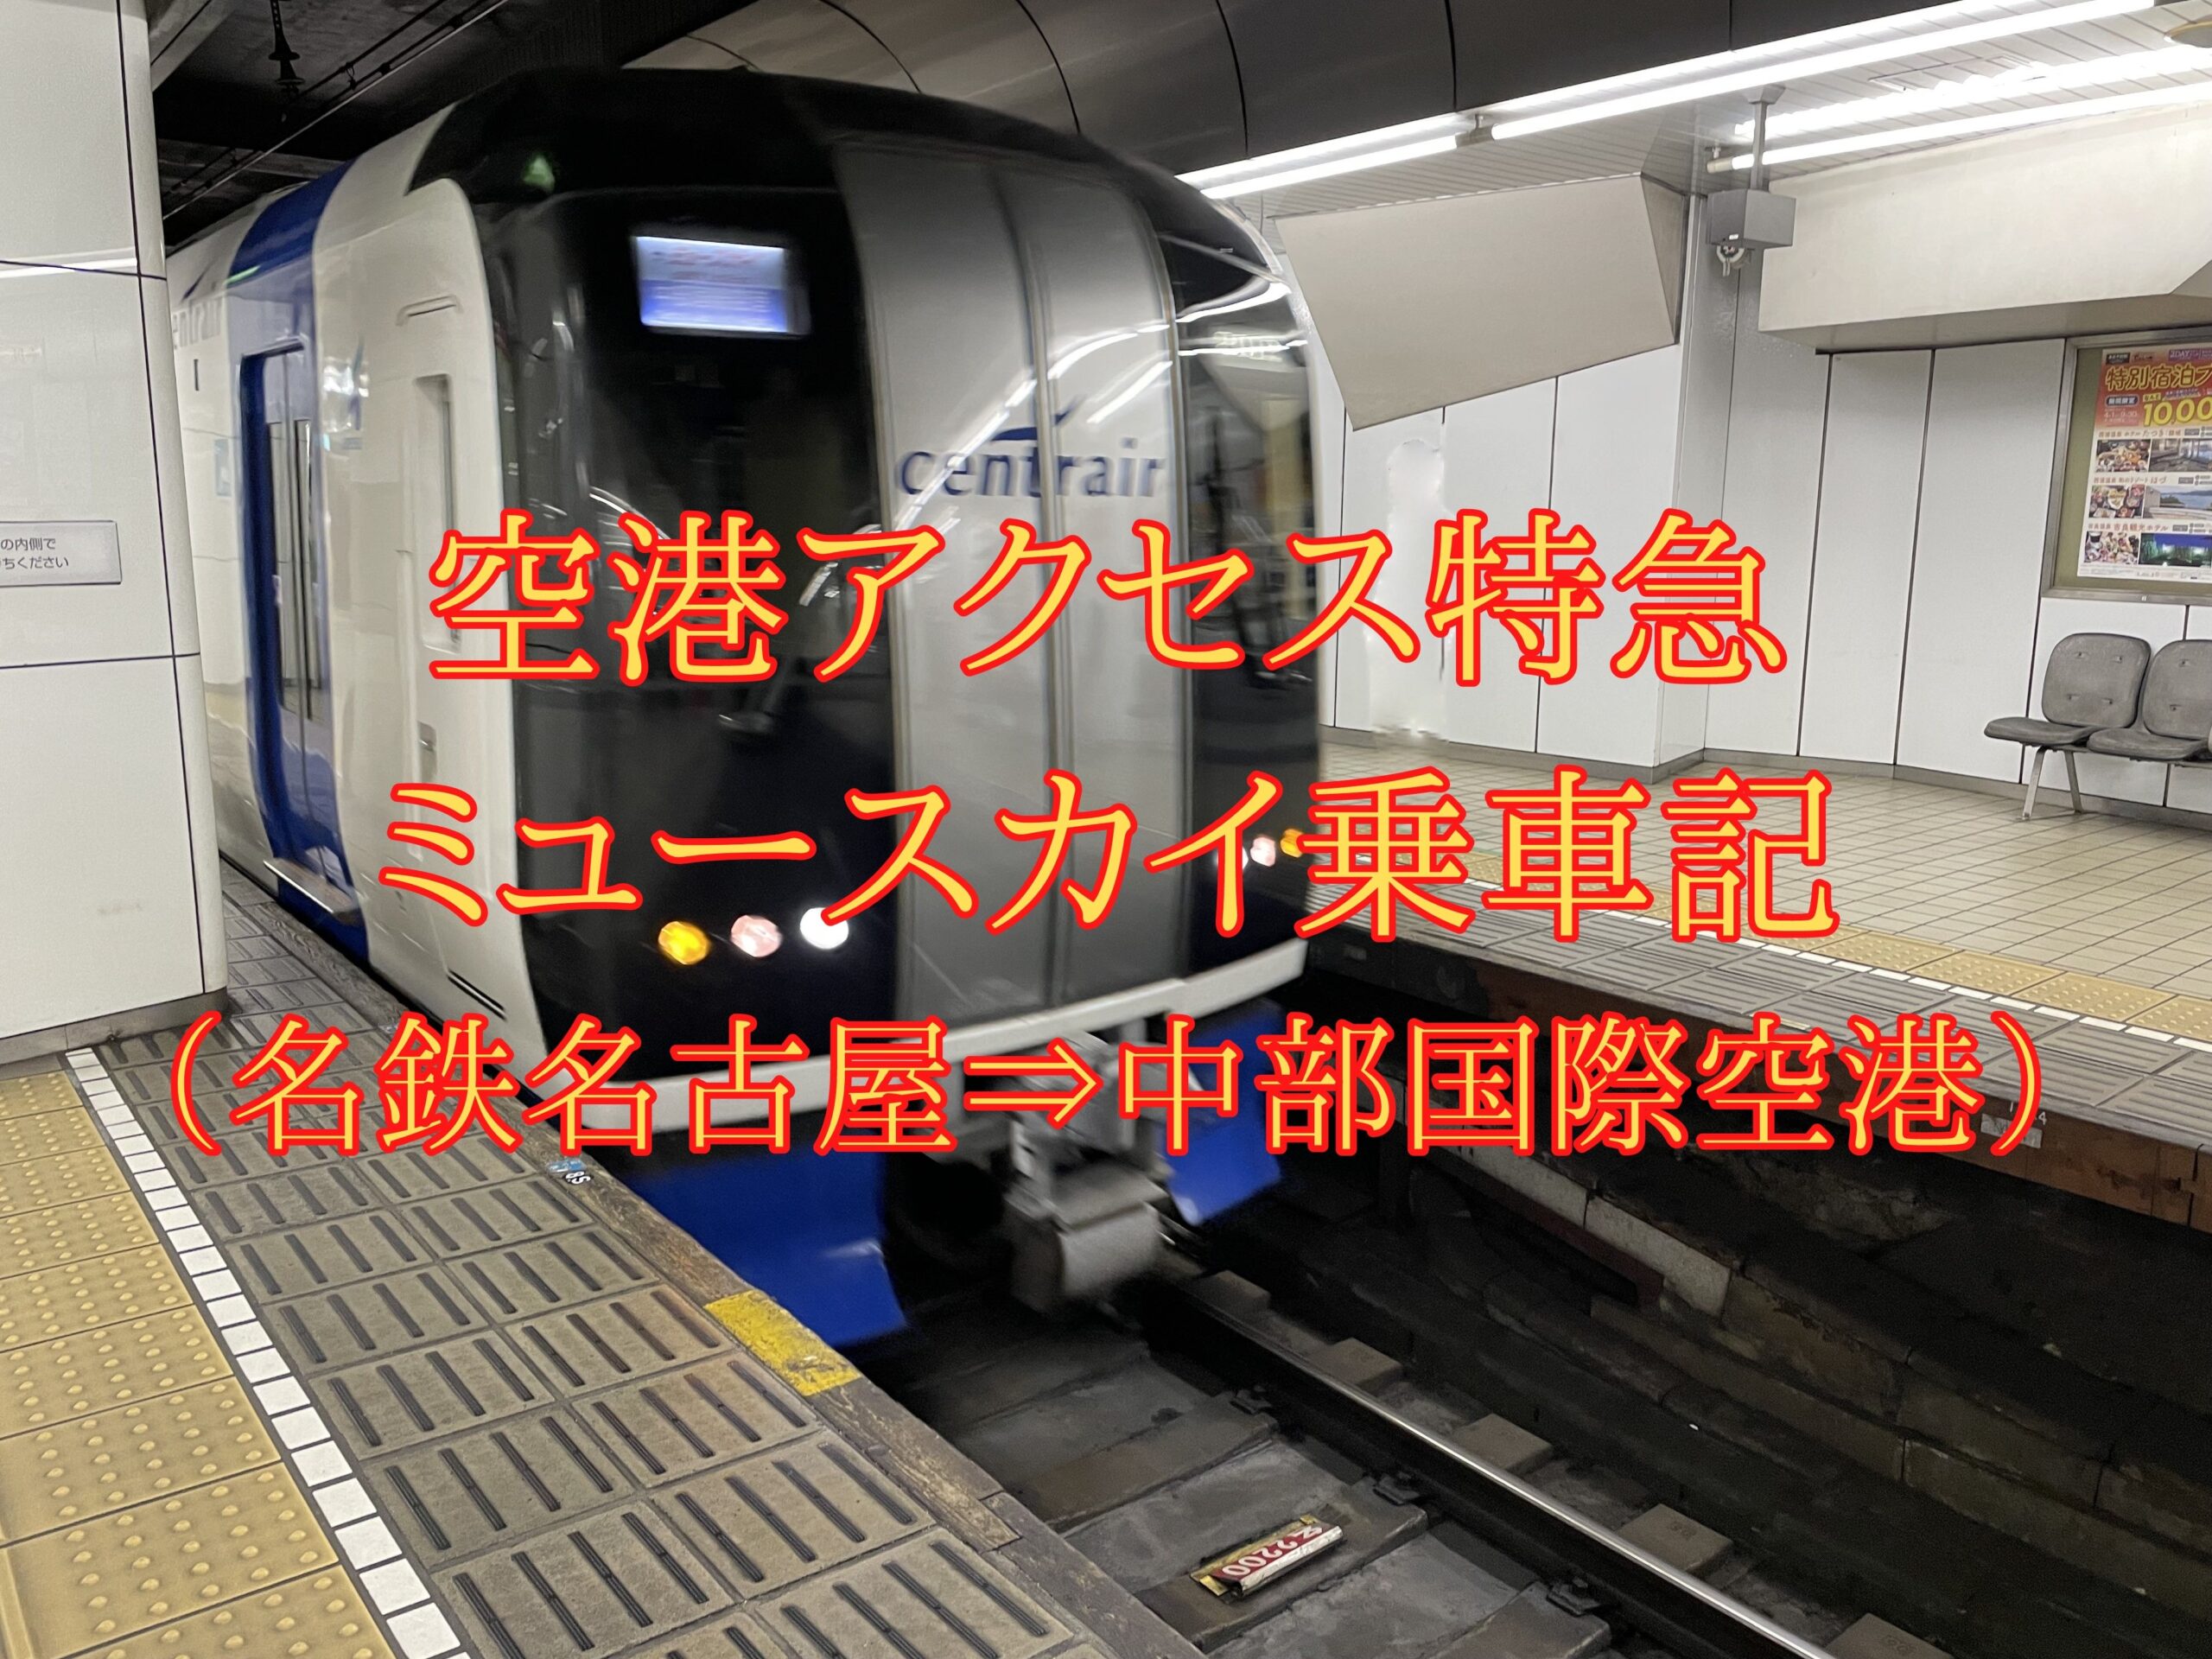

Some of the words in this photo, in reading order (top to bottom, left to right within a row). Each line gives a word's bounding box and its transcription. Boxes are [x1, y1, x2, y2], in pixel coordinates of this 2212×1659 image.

[896, 436, 1165, 498] centrair
[0, 537, 56, 550] の内側で
[0, 556, 69, 570] ちください
